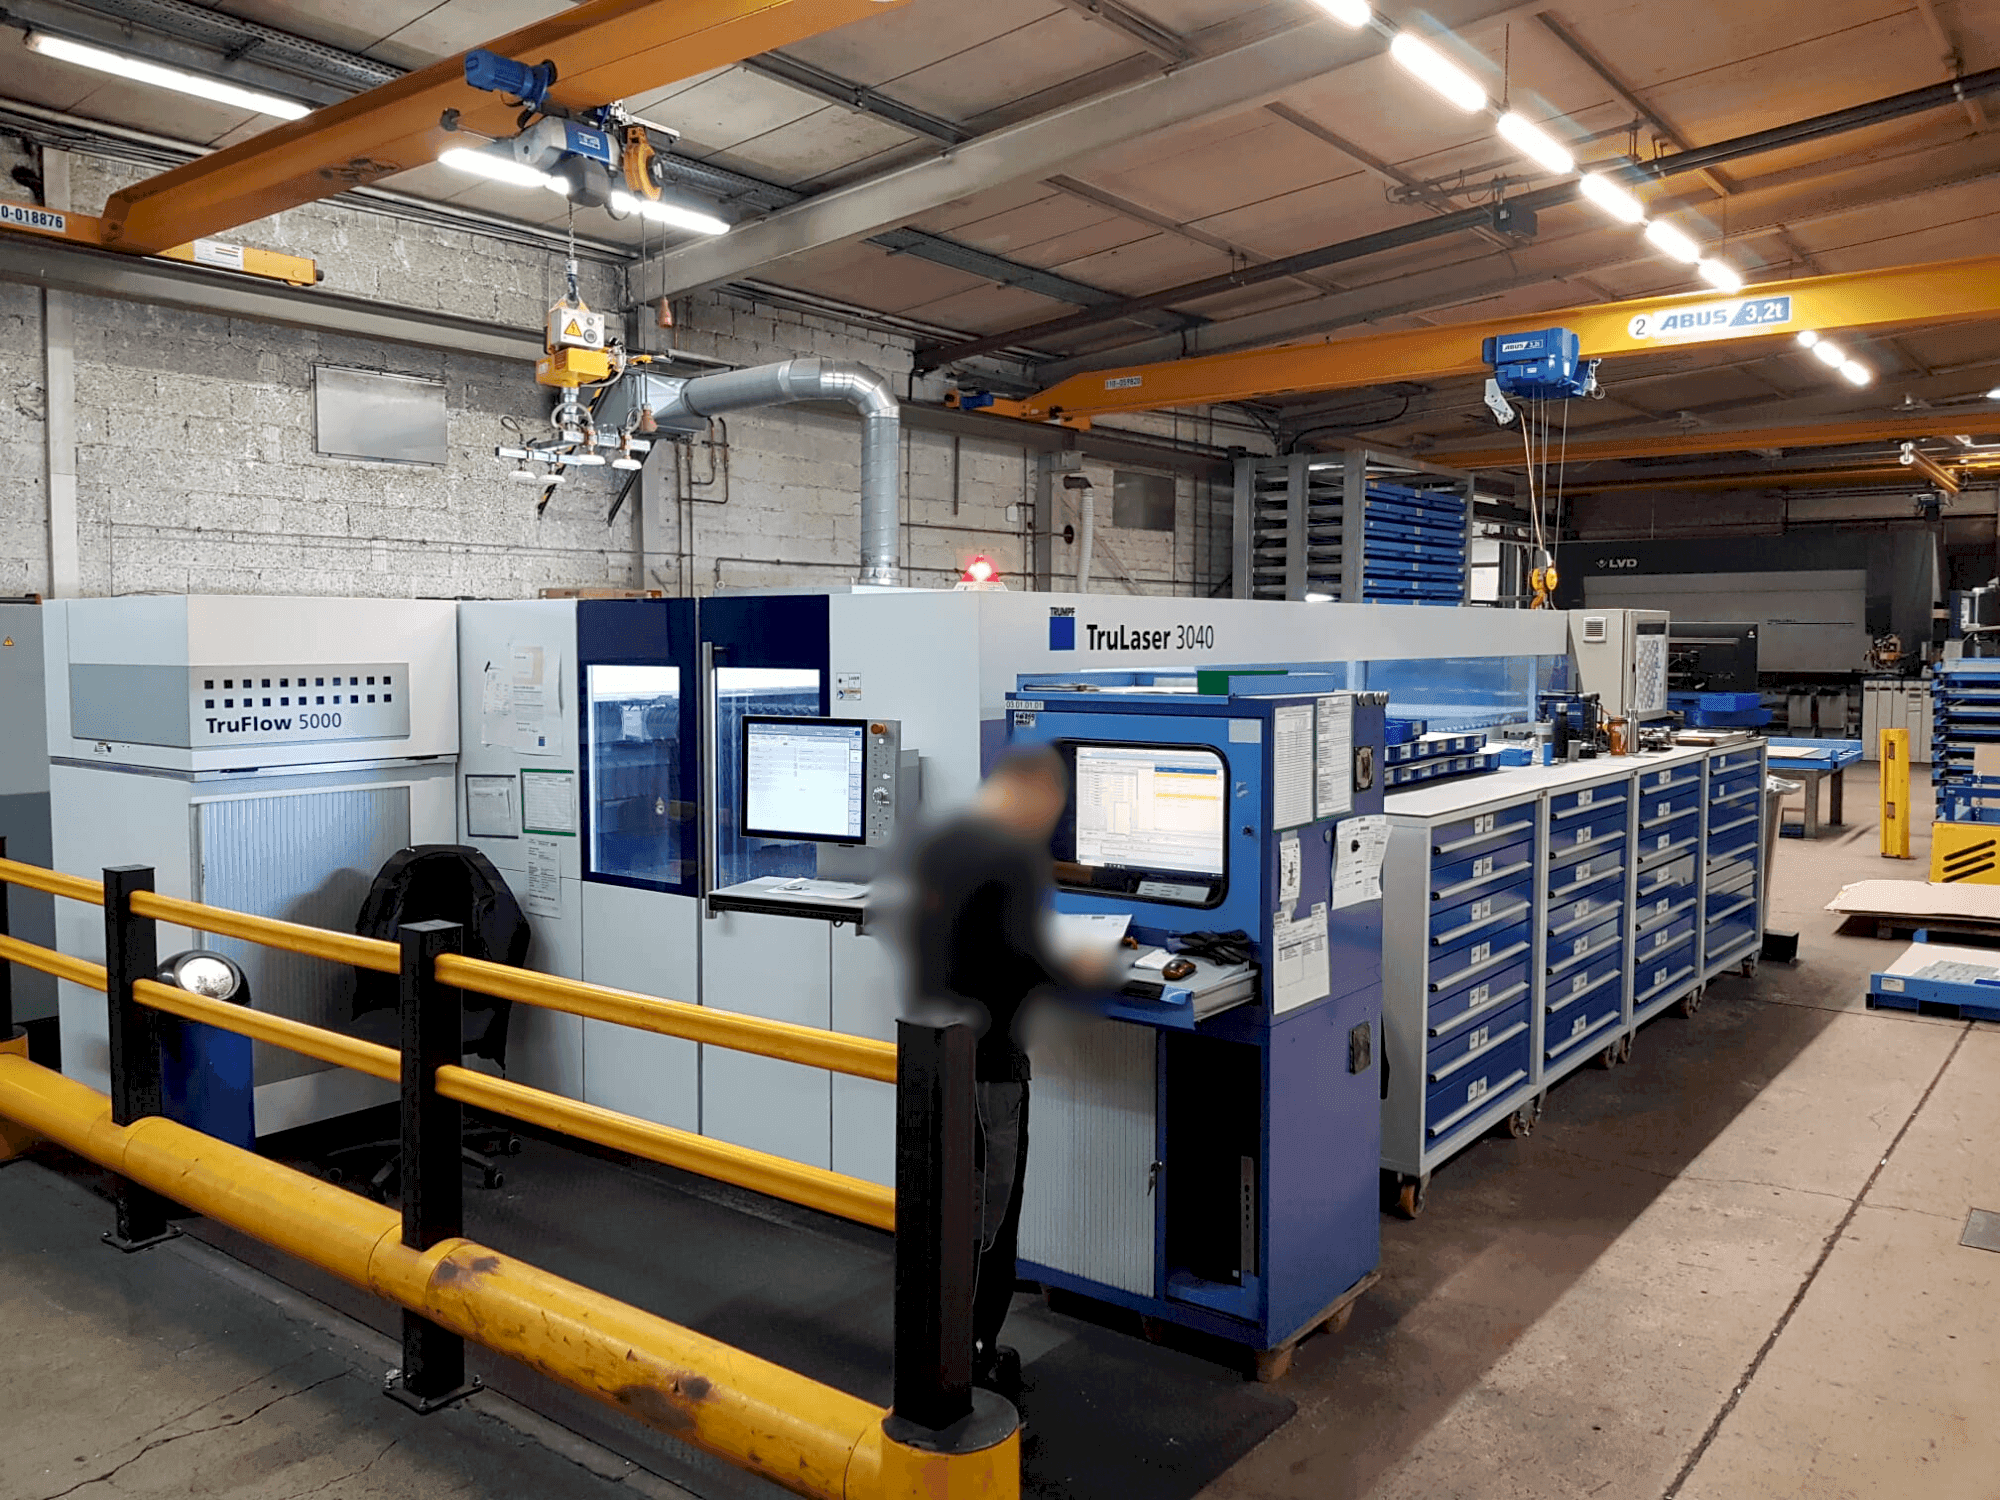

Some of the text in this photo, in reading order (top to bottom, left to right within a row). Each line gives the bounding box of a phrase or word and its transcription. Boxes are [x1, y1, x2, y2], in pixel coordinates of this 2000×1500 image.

[1635, 301, 1783, 335] 2 ABUS 3,2t
[1504, 342, 1525, 351] ABUS
[1609, 559, 1637, 567] LVD
[1050, 607, 1075, 616] TRUMPF
[1086, 624, 1214, 650] TruLaser 3040
[205, 712, 342, 734] TruFlow 5000
